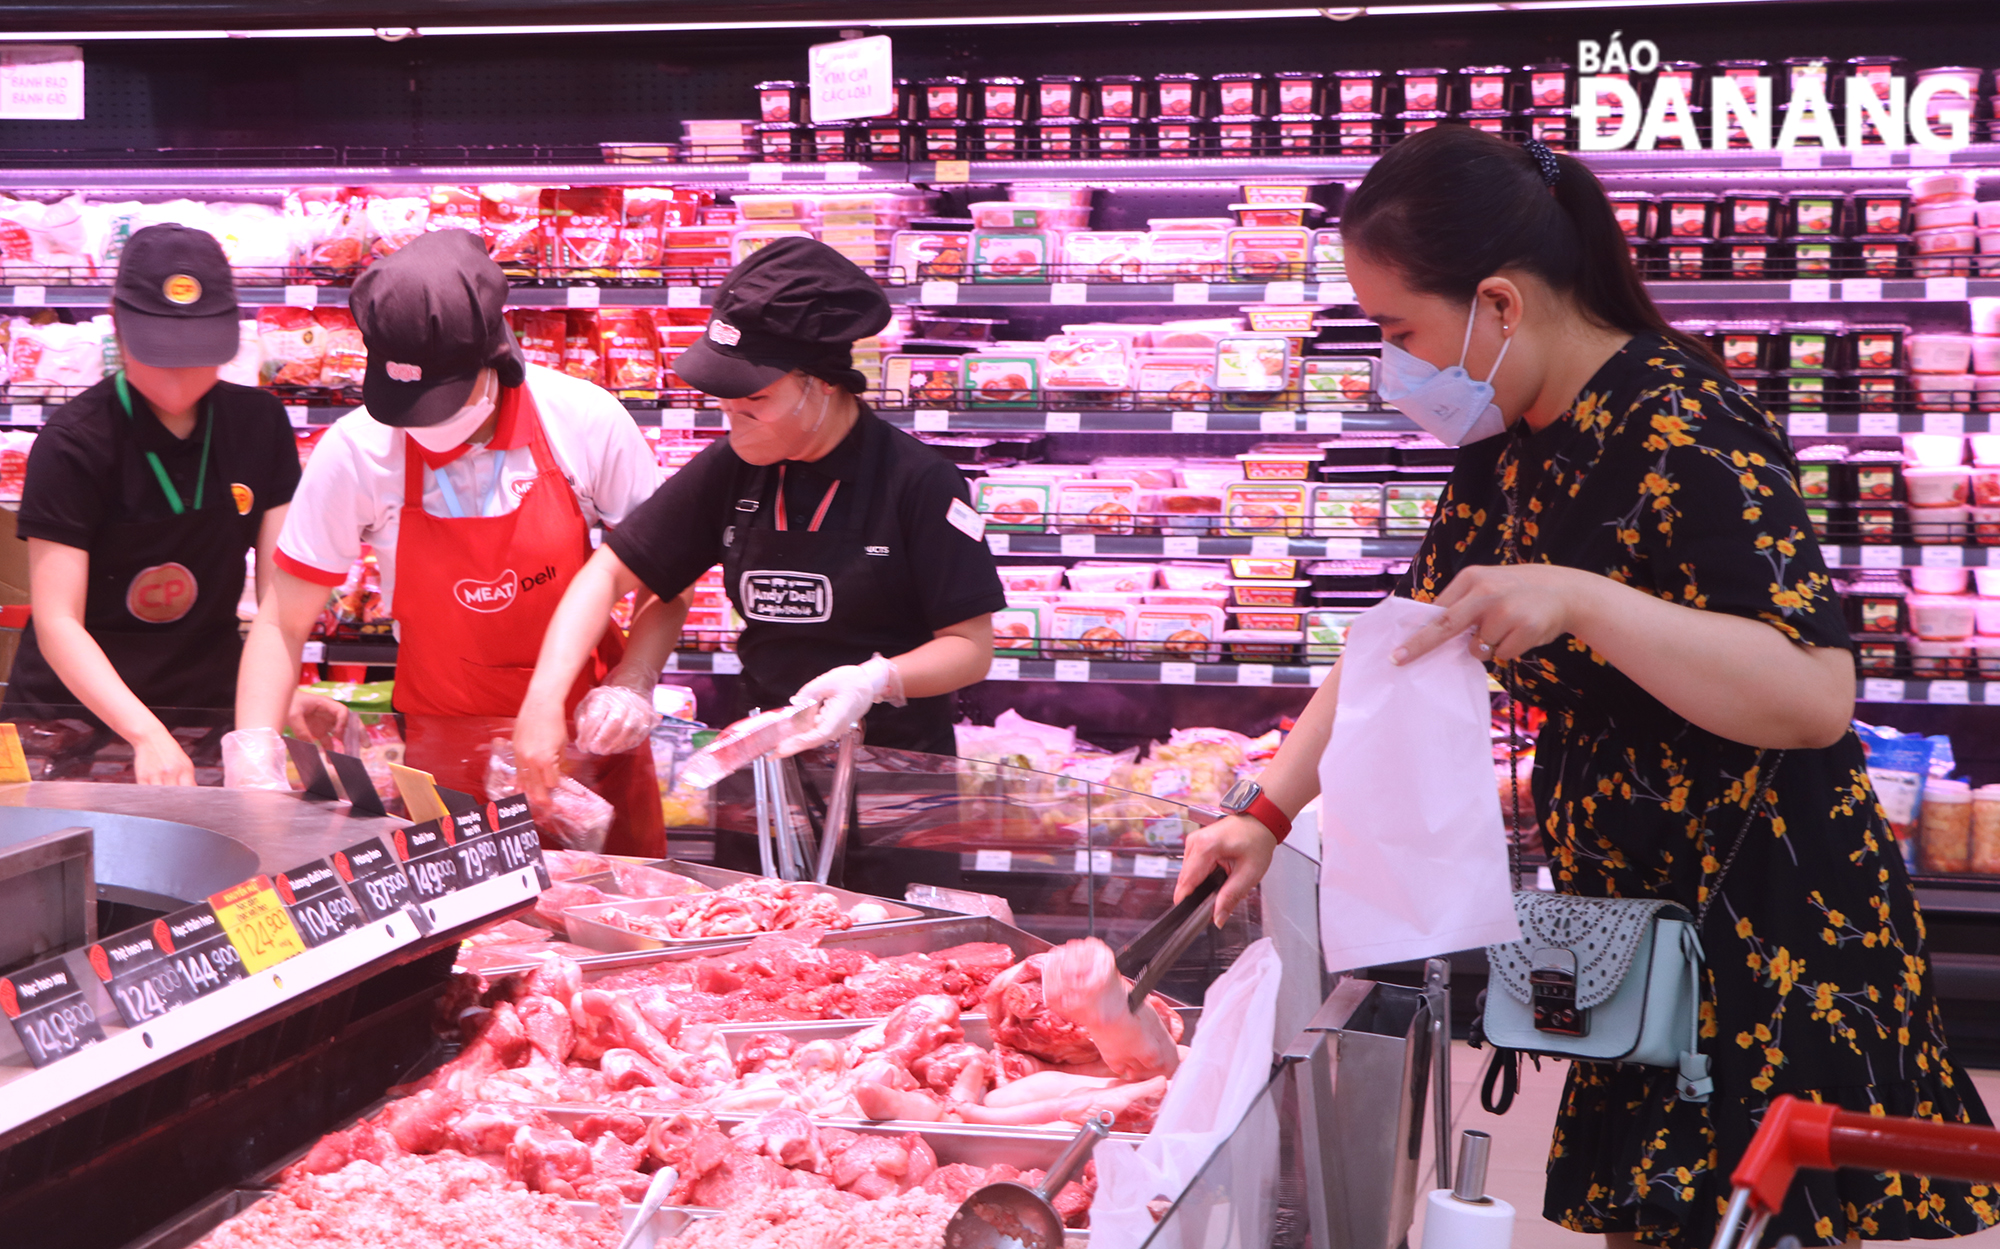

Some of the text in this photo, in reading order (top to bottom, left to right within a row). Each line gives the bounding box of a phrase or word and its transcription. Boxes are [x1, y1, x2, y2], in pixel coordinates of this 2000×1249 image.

[138, 579, 185, 608] CP
[463, 565, 557, 603] MEAT Deli
[789, 590, 816, 604] Deli
